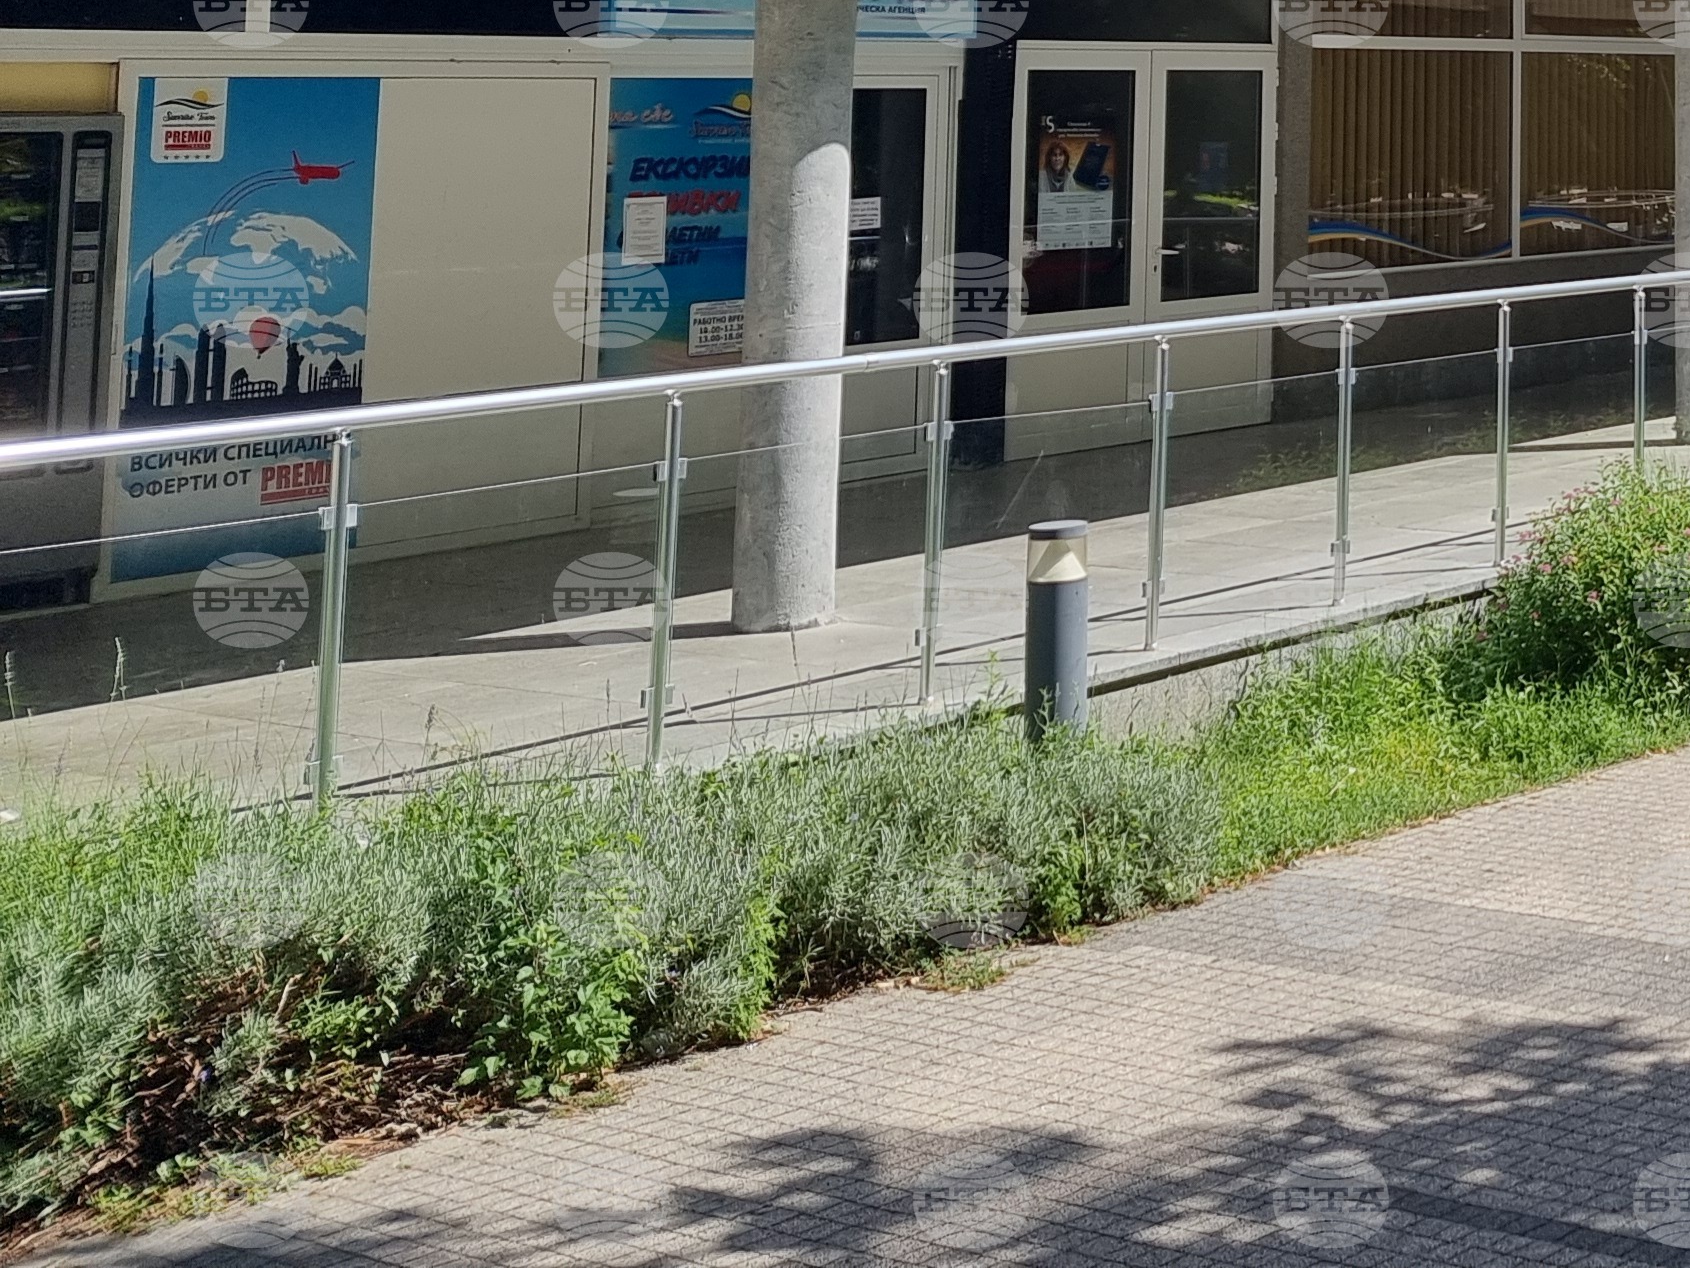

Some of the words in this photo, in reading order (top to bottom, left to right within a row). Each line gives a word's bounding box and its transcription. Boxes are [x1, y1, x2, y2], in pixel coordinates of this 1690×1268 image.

[164, 130, 212, 144] PREMIO
[129, 447, 218, 473] ВСИЧКИ
[223, 433, 343, 462] СПЕЦИАЛН
[128, 473, 218, 499] ОФЕРТИ
[222, 468, 253, 488] ОТ
[260, 459, 333, 492] PREMI
